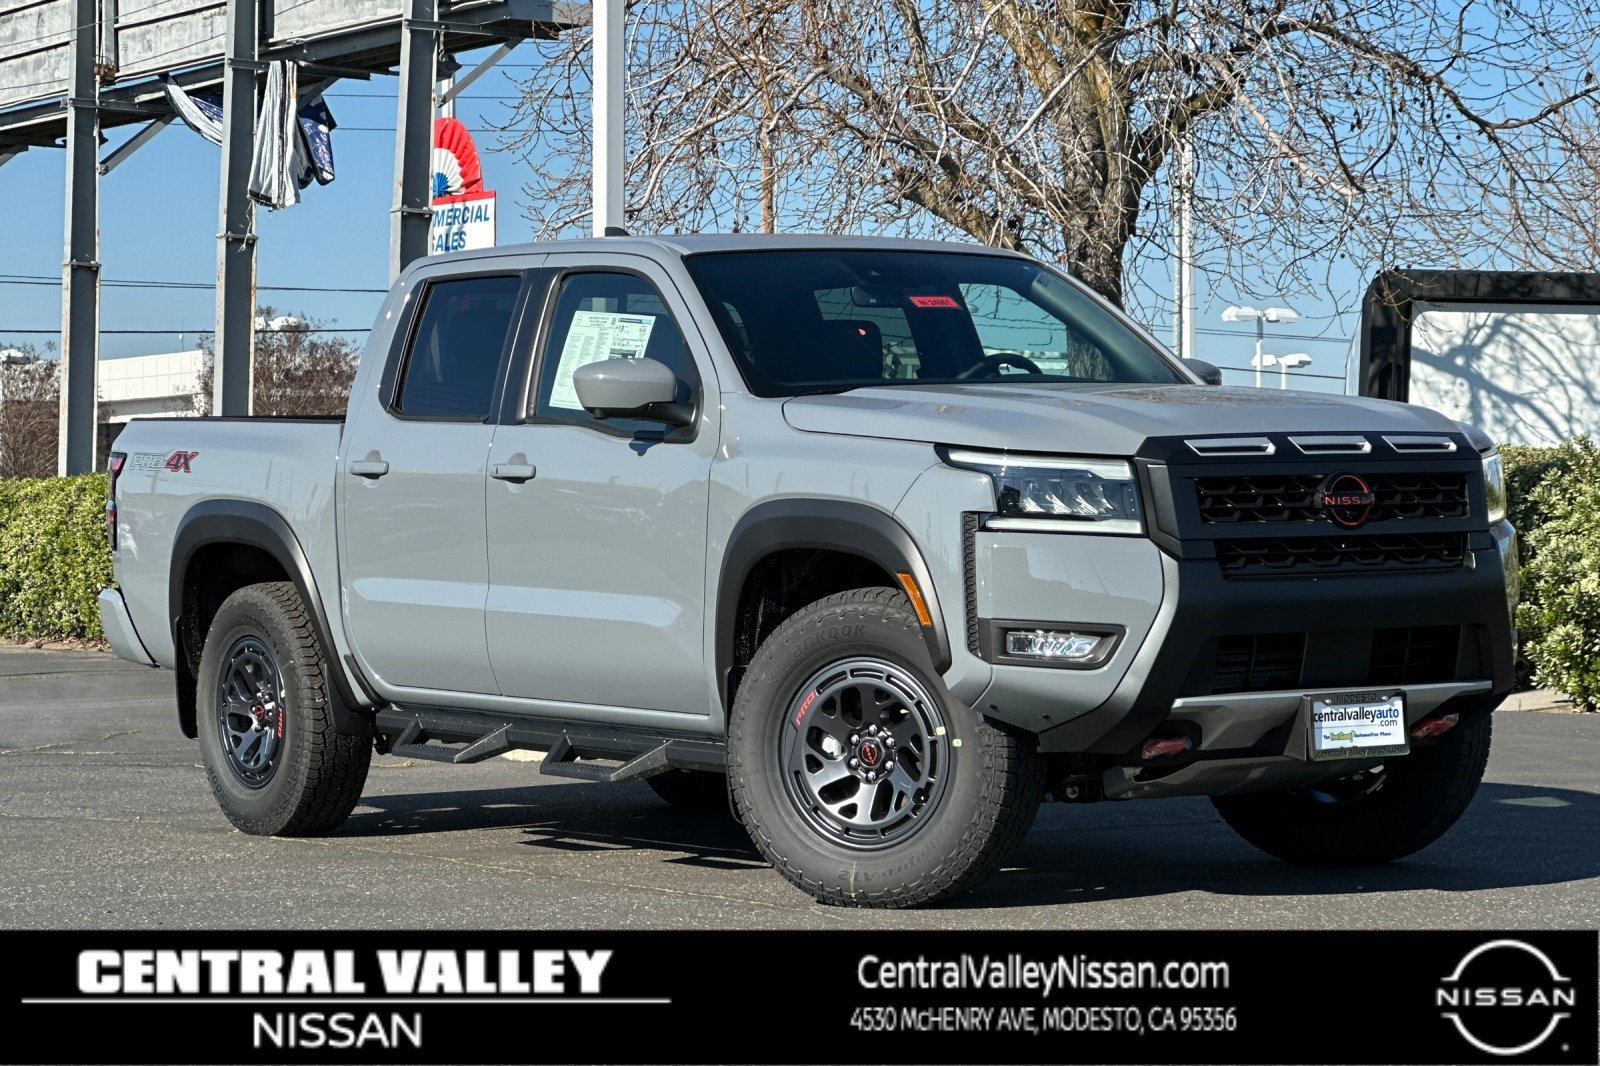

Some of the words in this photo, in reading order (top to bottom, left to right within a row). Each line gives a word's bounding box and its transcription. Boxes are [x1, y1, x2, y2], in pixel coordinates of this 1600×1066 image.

[433, 204, 490, 228] MERCIAL
[433, 230, 467, 252] ALES
[1313, 706, 1400, 723] centralvalleyauto
